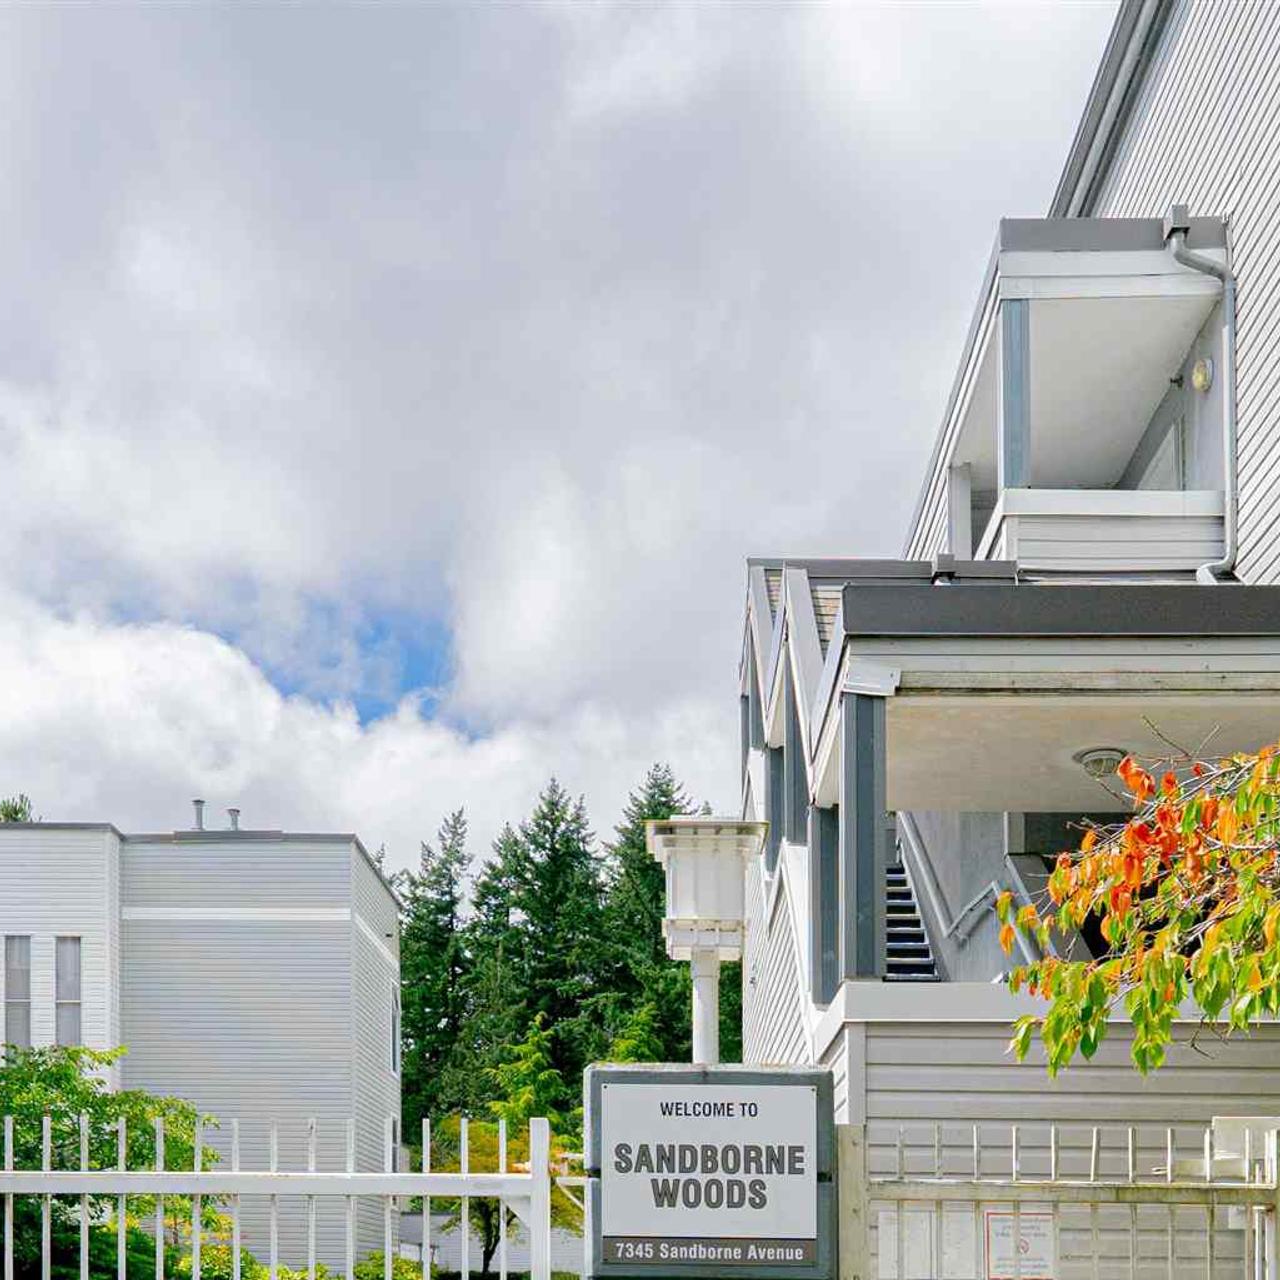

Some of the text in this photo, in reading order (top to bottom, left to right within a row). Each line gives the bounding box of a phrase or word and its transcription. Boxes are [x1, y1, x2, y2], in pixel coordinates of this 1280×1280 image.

[660, 1102, 758, 1117] WELCOME TO
[614, 1143, 805, 1174] SANDBORNE
[651, 1178, 767, 1210] WOODS
[615, 1243, 804, 1260] 7345 Sandborne Avenue
